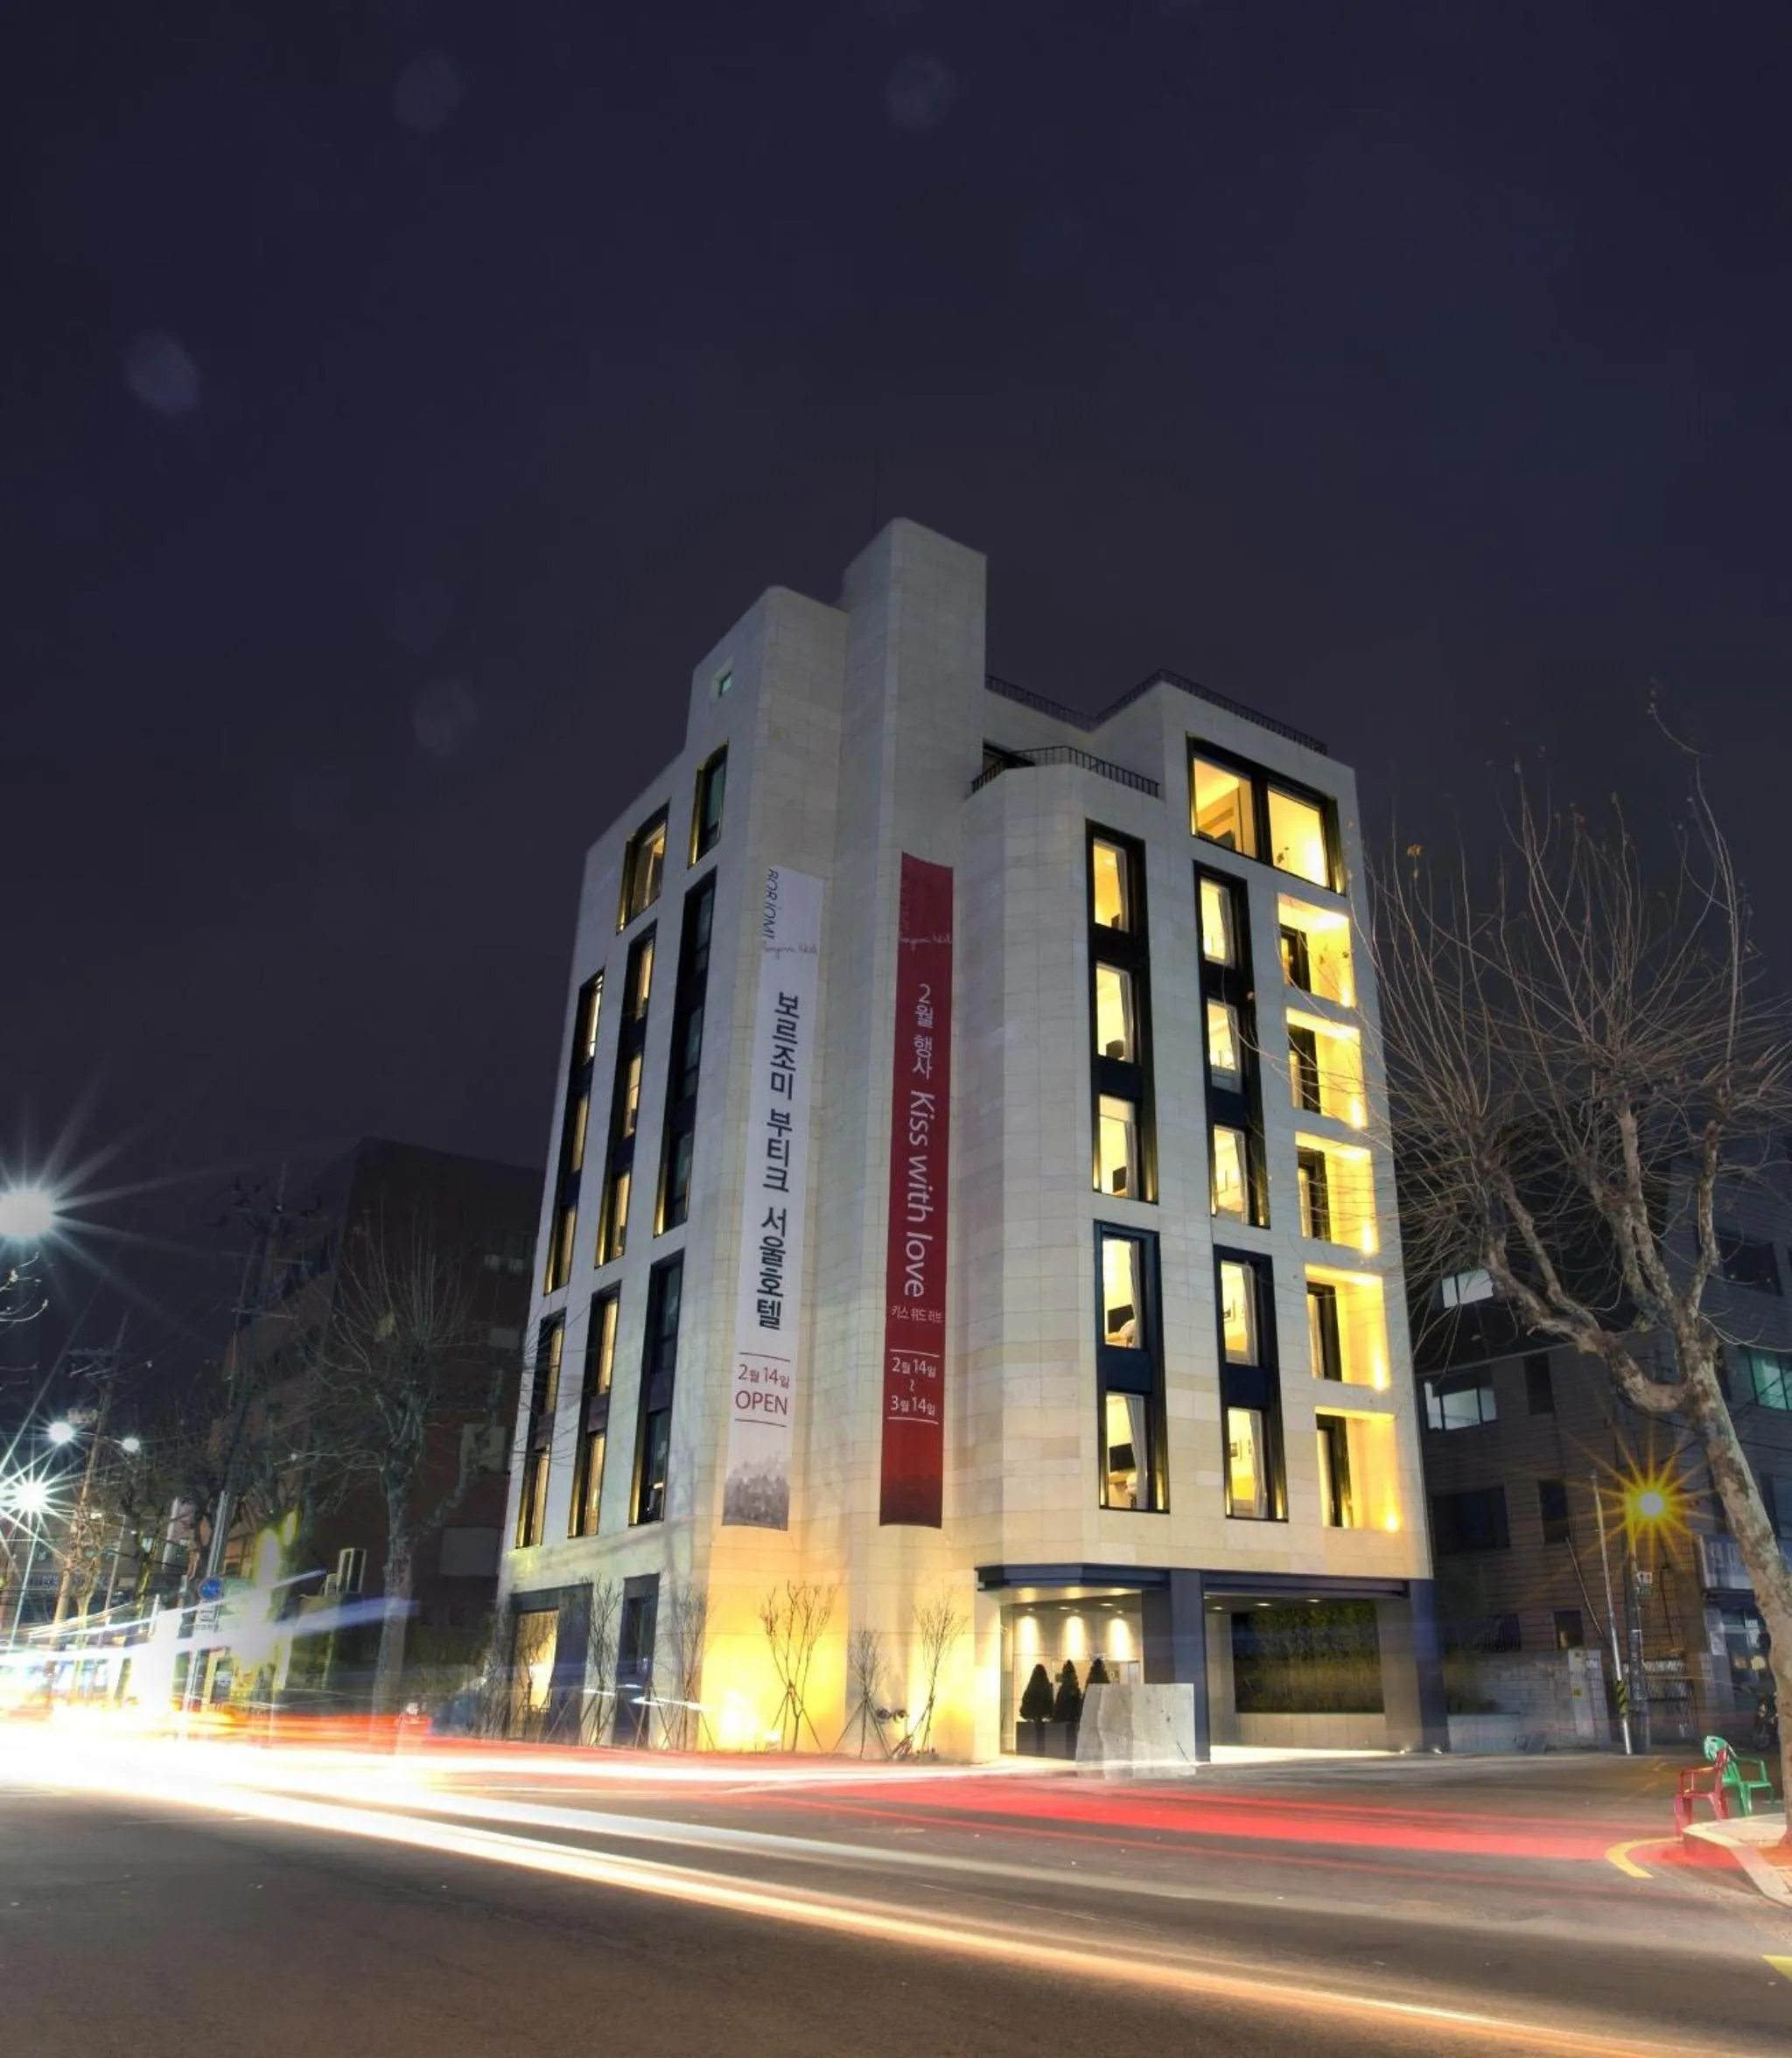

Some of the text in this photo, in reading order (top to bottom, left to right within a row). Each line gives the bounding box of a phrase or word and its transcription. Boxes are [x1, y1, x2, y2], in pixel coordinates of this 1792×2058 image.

[914, 984, 934, 1029] 2월
[770, 991, 800, 1100] 보르조미
[912, 1034, 933, 1081] 행사
[909, 1089, 935, 1147] Kiss
[763, 1109, 793, 1193] 부티크
[906, 1155, 934, 1223] with
[755, 1207, 788, 1331] 서울호텔
[904, 1230, 933, 1298] love
[738, 1363, 790, 1389] 2월 14일
[892, 1356, 937, 1378] 2월 14일
[735, 1390, 788, 1416] OPEN
[890, 1395, 936, 1416] 3월 14일
